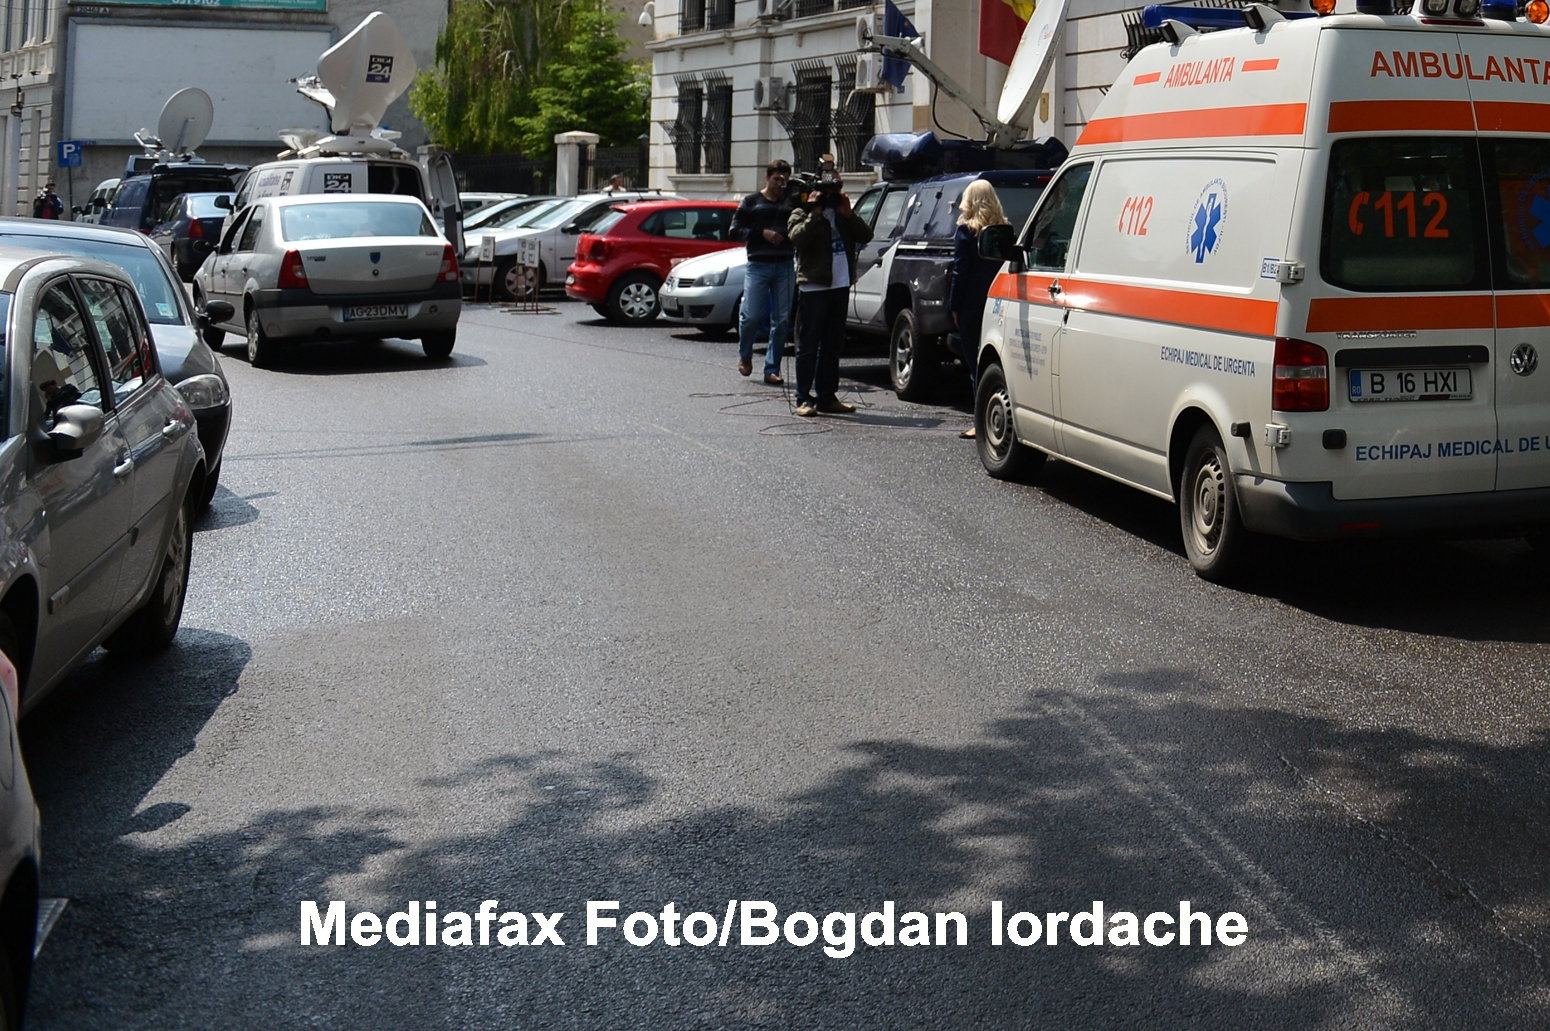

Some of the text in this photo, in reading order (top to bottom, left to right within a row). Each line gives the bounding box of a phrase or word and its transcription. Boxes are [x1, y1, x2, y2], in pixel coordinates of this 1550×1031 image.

[370, 63, 391, 79] 24
[1163, 56, 1236, 89] AMBULANTA
[63, 144, 76, 159] P
[325, 181, 350, 193] 24
[1128, 196, 1153, 235] 112
[1374, 190, 1450, 238] 112
[1161, 346, 1256, 377] ECHIPAJ MEDICAL DE URGENTA
[1370, 371, 1458, 394] B 16 HXI
[1356, 444, 1432, 461] ECHIPAJ
[1438, 439, 1514, 457] MEDICAL
[1518, 436, 1541, 452] DE
